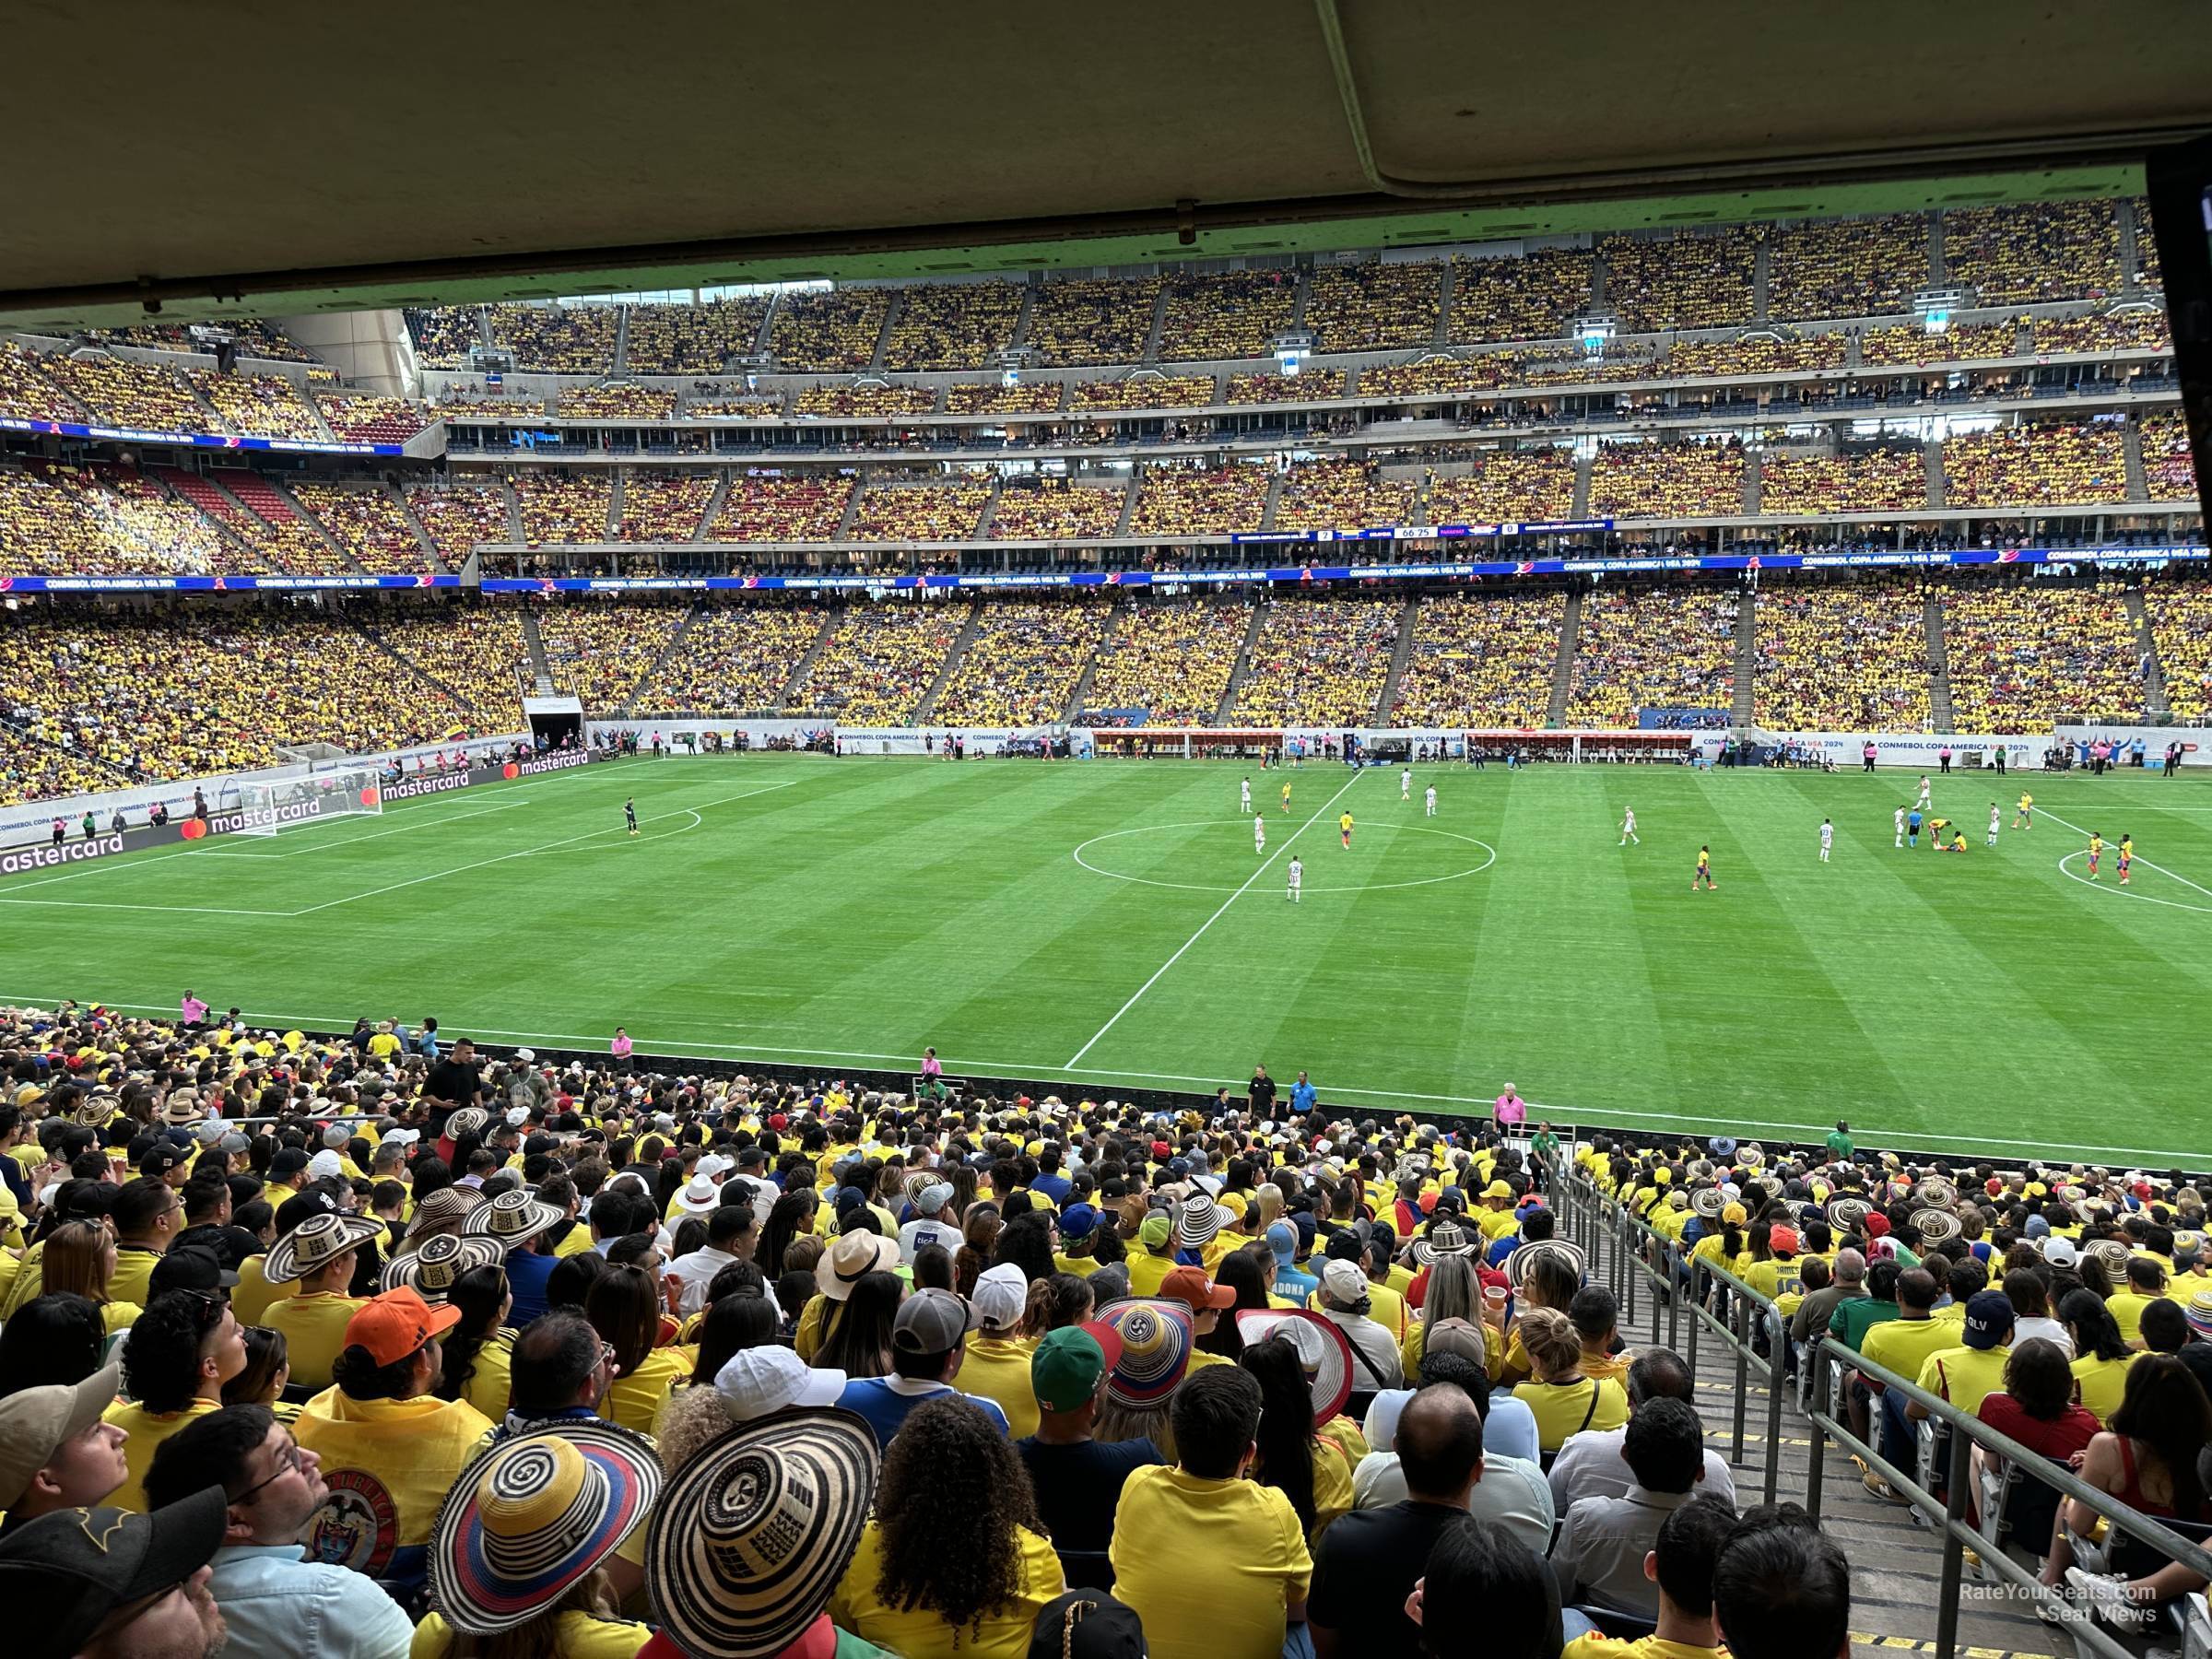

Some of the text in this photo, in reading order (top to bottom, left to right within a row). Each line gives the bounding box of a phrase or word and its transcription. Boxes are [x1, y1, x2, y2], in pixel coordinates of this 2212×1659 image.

[1802, 554, 1951, 565] CONMEBOL COPA AMERICA USA 2024
[2047, 548, 2210, 560] CONMEBOL COPA AMERICA USA 202
[1349, 568, 1386, 577] CONMEBOL
[1388, 567, 1407, 575] COPA
[1408, 566, 1440, 575] AMERICA
[1441, 566, 1455, 574] USA
[1564, 562, 1606, 571] CONMEBOL
[1606, 561, 1627, 570] COPA
[1627, 561, 1664, 569] AMERICA
[46, 579, 176, 588] CONMEBOL COPA AMERICA USA 2024
[256, 579, 295, 587] CONMEBOL
[295, 579, 315, 587] COPA
[590, 580, 628, 589] CONMEBOL
[629, 580, 647, 588] COPA
[784, 579, 820, 587] CONMEBOL
[522, 751, 588, 775] mastercard
[383, 771, 469, 800] mastercard
[117, 804, 147, 812] CONMEBOL
[34, 818, 50, 827] COPA
[51, 814, 78, 823] AERICA
[212, 797, 321, 833] mastercard
[2, 834, 124, 873] astercard
[1776, 1266, 1799, 1274] JAMES
[1272, 1282, 1305, 1296] ADONA
[1777, 1278, 1804, 1296] 10
[1968, 1316, 1987, 1331] GLV
[326, 1474, 392, 1528] PUBLICA
